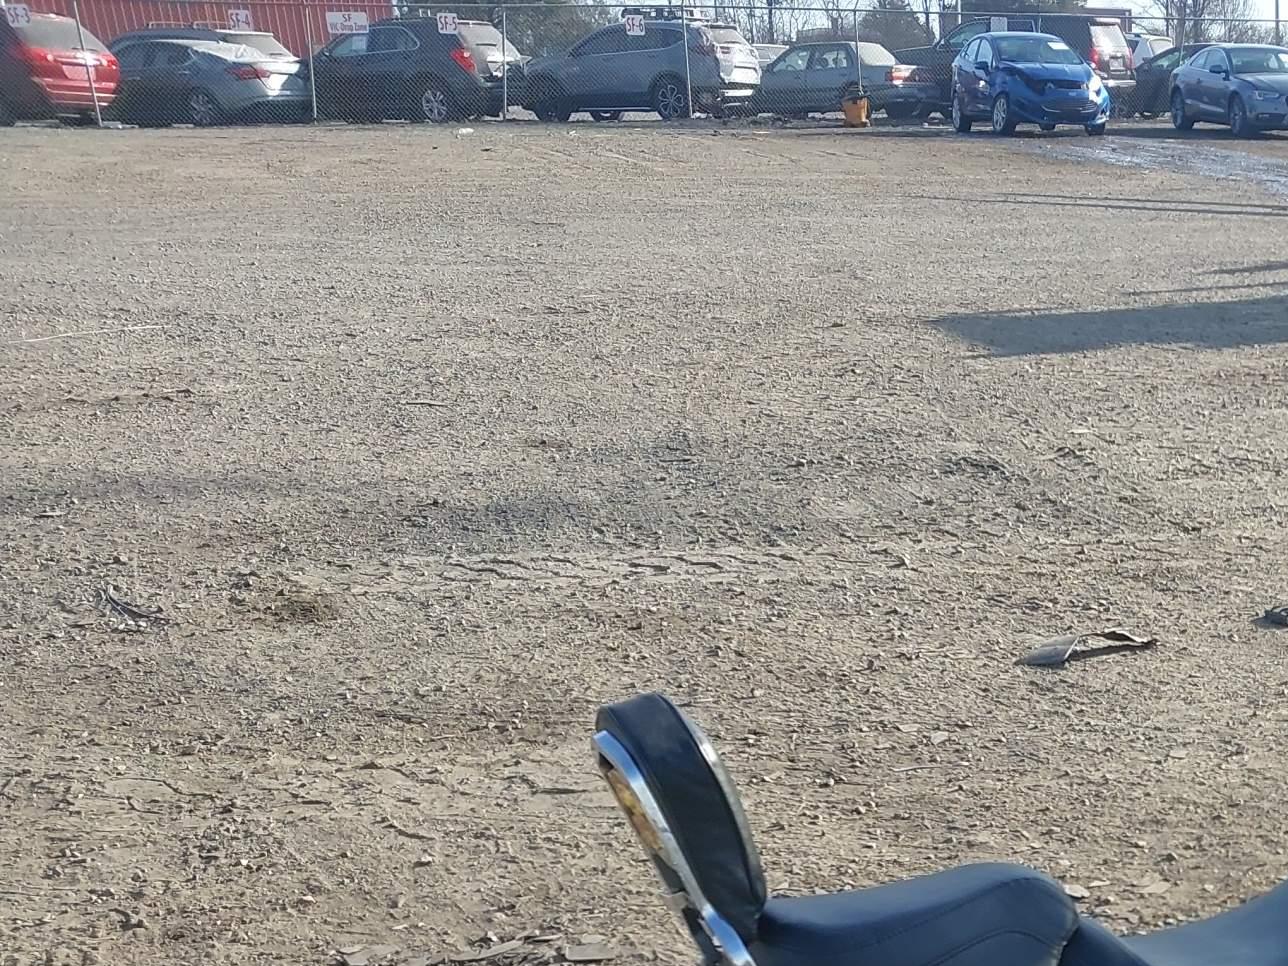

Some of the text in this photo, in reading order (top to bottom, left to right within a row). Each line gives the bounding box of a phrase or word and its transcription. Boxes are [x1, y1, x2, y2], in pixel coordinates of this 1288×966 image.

[7, 7, 30, 24] SF-3
[230, 12, 250, 29] SF-4
[342, 13, 353, 22] SF
[439, 15, 457, 31] SF-5
[626, 17, 644, 32] SF-6
